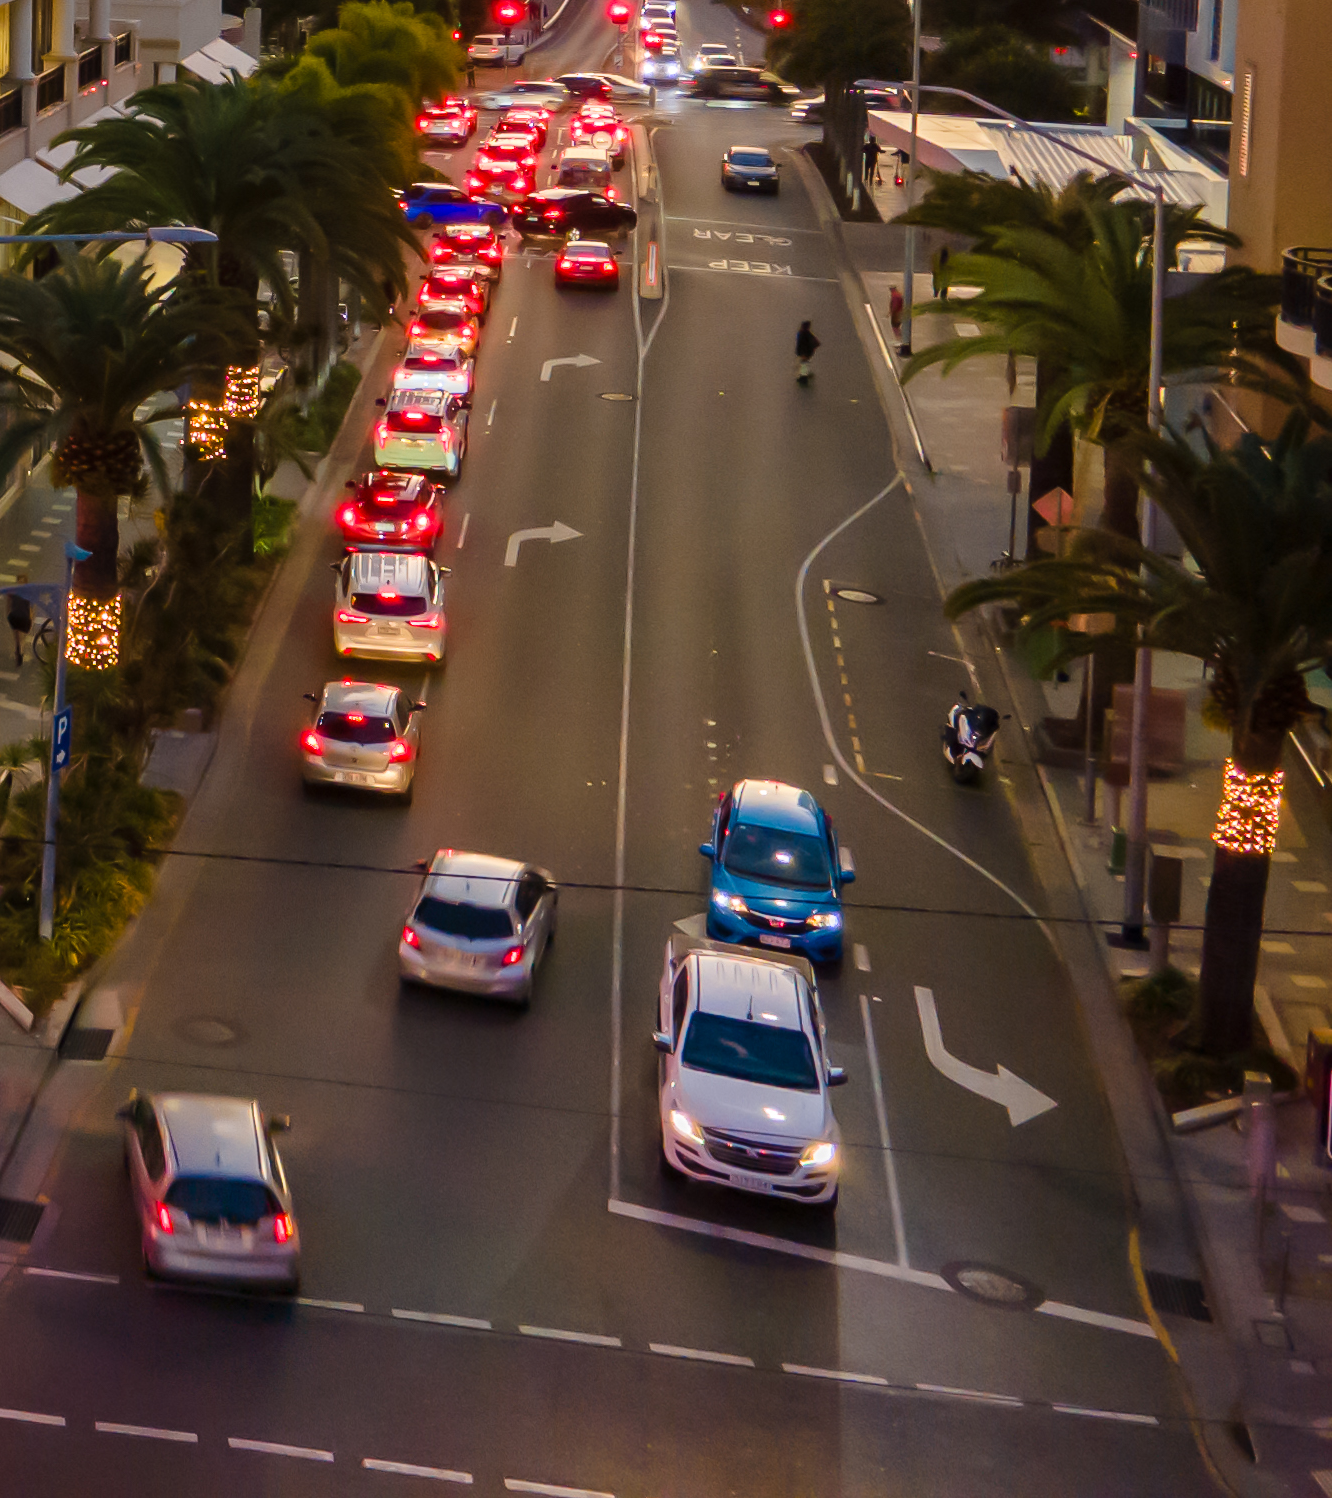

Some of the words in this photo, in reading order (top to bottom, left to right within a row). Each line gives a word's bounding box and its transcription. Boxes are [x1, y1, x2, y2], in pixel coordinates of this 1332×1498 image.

[693, 228, 792, 246] CLEAR
[708, 259, 792, 276] KEEP
[58, 716, 68, 745] P
